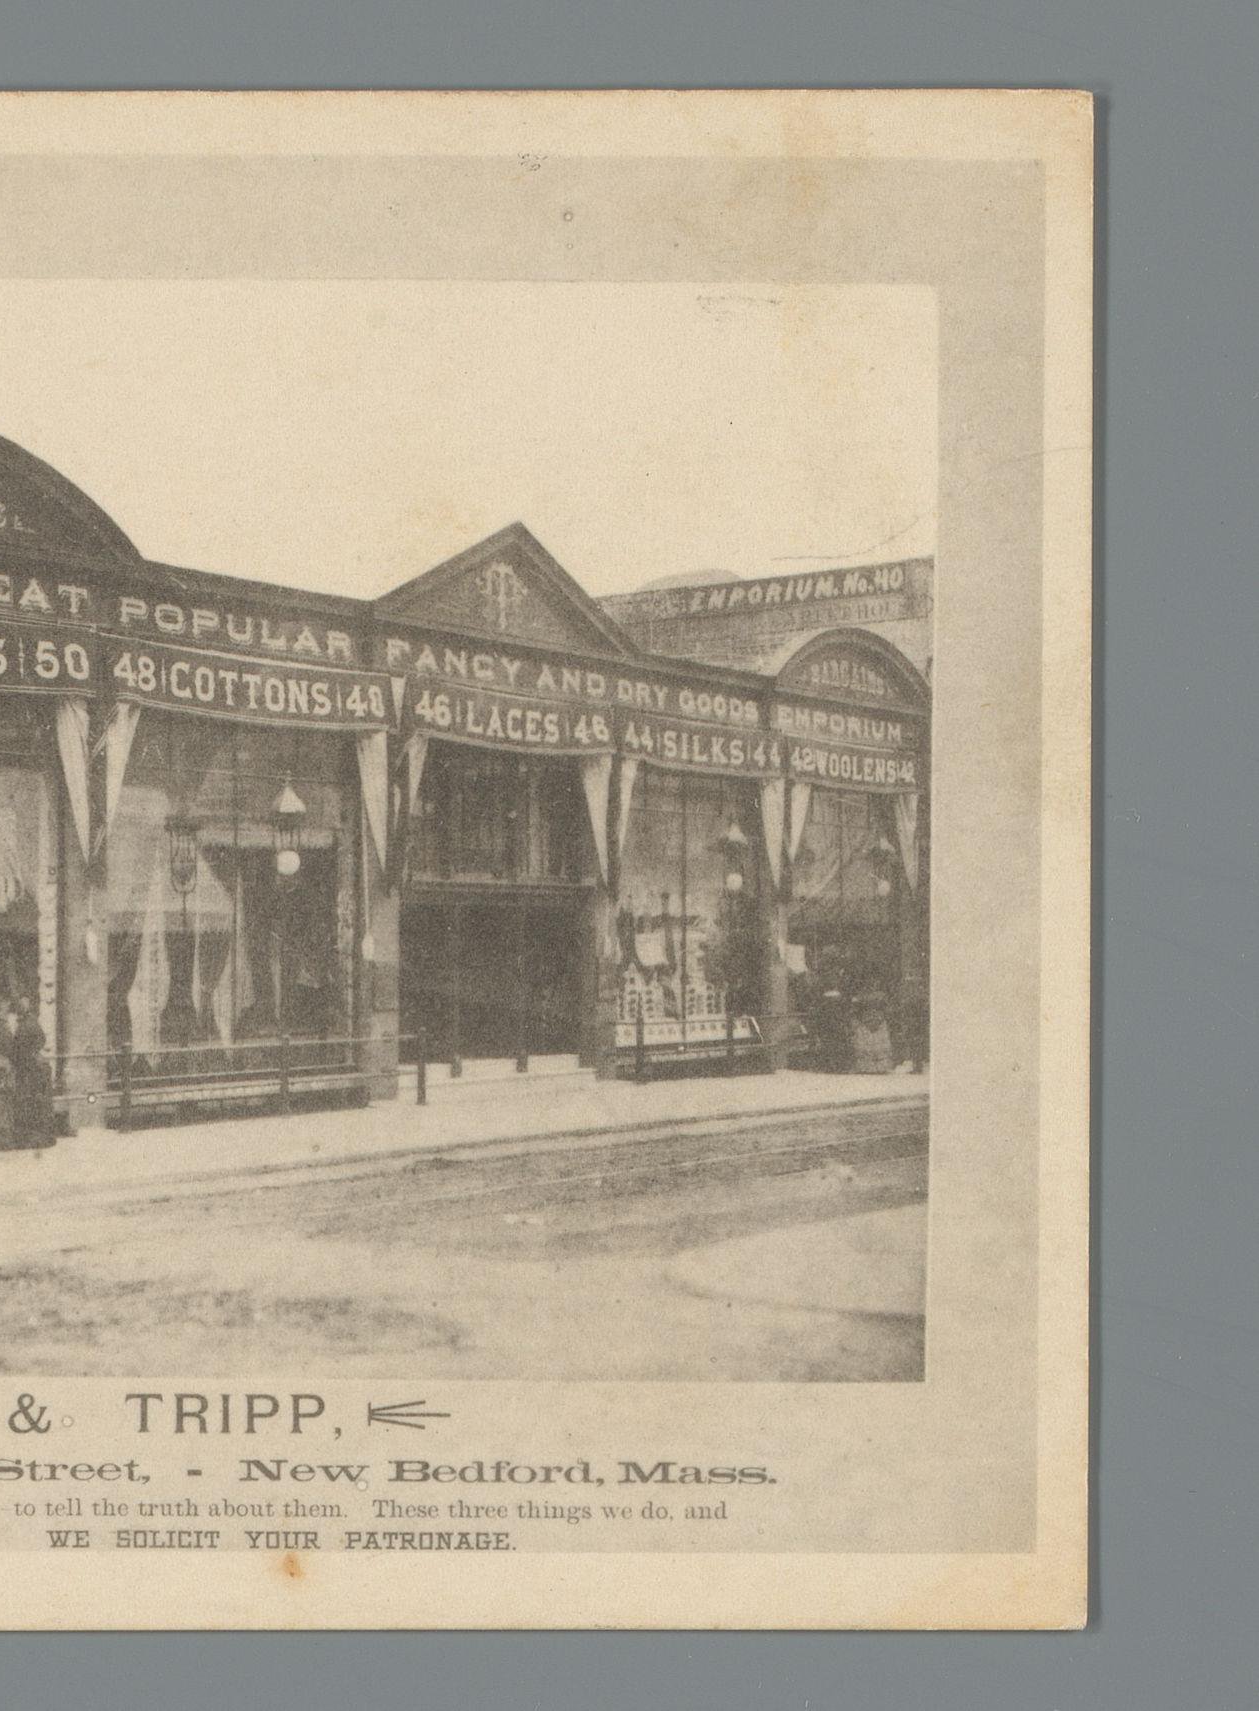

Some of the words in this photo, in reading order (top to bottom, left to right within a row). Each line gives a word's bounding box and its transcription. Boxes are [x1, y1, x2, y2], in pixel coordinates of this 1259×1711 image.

[873, 567, 905, 591] 40
[33, 640, 91, 681] 50
[118, 597, 352, 665] POPULAR
[386, 638, 522, 687] FANCY
[536, 663, 606, 698] AND
[617, 678, 668, 710] DRY
[679, 687, 759, 724] GOODS
[776, 704, 903, 743] EMPORIUM
[113, 650, 156, 692] 48
[170, 660, 332, 717] COTTONS
[414, 689, 452, 727] 46
[466, 699, 560, 744] LACES
[624, 721, 654, 753] 44
[663, 730, 745, 766] SILKS
[753, 741, 782, 769] 44
[791, 746, 816, 772] 42
[816, 749, 897, 784] WOOLENS
[7, 1393, 52, 1434] &
[125, 1393, 342, 1440] TRIPP,
[387, 1460, 605, 1487] Bedford,
[617, 1461, 778, 1485] Mass.
[44, 1497, 83, 1517] tell
[91, 1497, 129, 1517] the
[137, 1497, 200, 1518] truth
[208, 1497, 275, 1518] about
[282, 1498, 348, 1519] them.
[371, 1498, 440, 1519] These
[447, 1498, 508, 1519] three
[516, 1499, 593, 1525] things
[600, 1504, 633, 1520] we
[640, 1500, 674, 1522] do,
[684, 1500, 728, 1520] and
[45, 1529, 91, 1550] WE
[115, 1529, 221, 1551] SOLICIT
[243, 1529, 322, 1551] YOUR
[343, 1530, 517, 1552] PATRONAGE.
